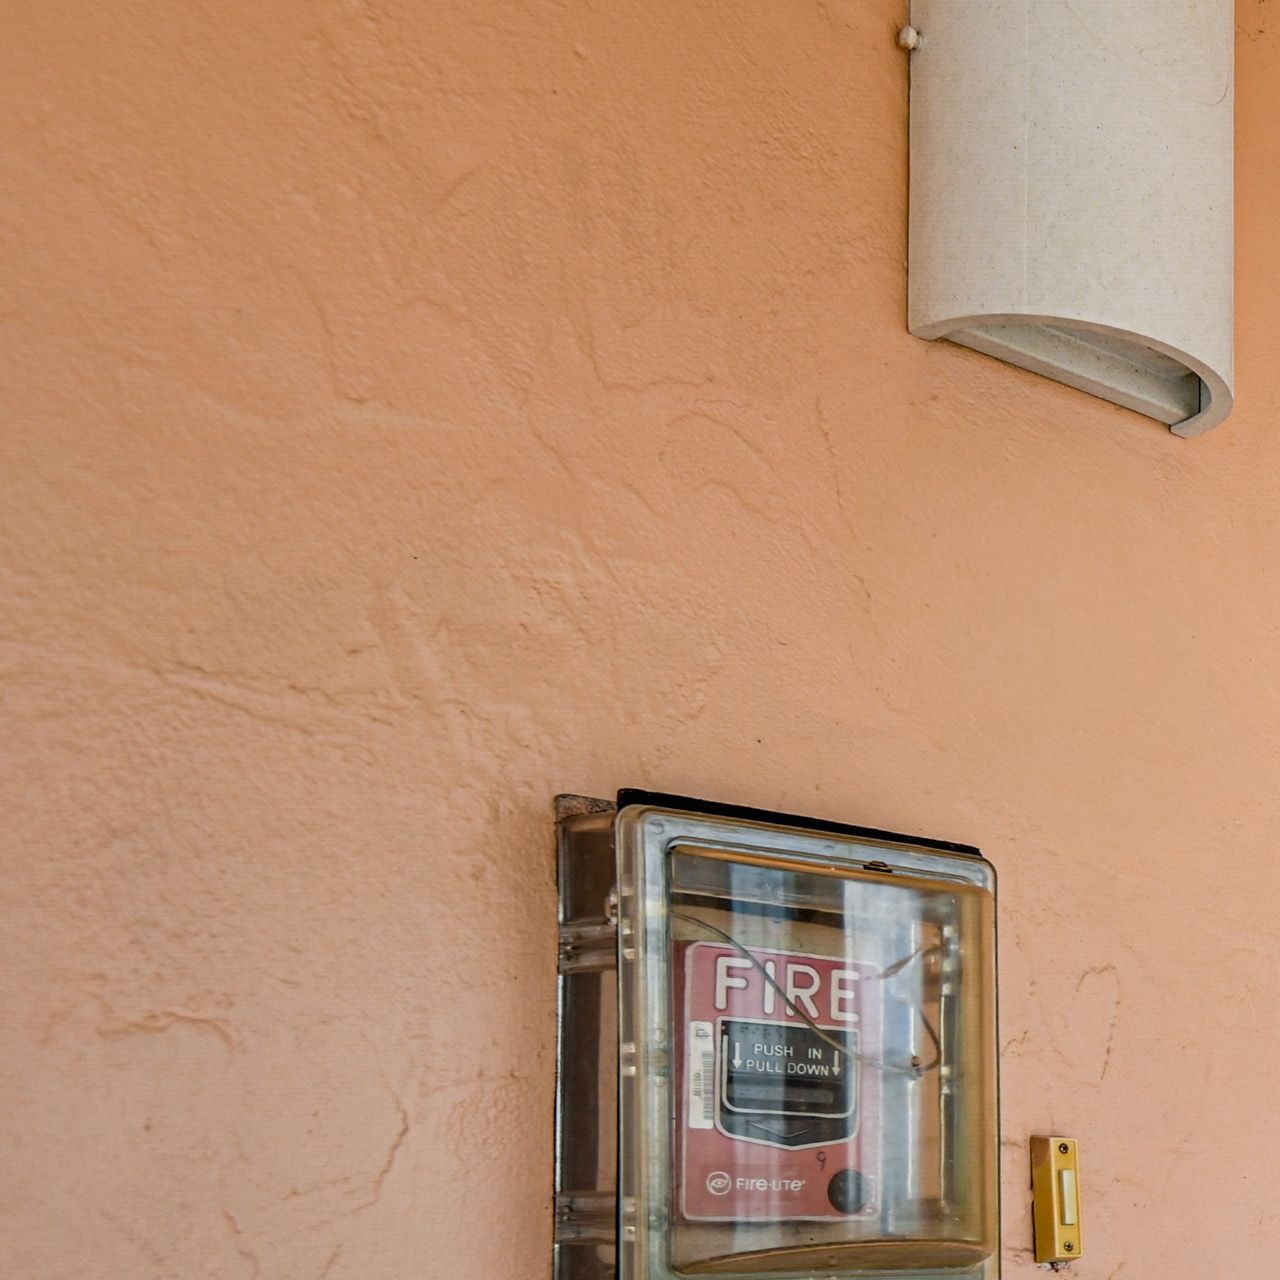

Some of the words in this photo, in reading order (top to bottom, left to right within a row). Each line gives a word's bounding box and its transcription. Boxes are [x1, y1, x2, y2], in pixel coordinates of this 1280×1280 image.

[715, 956, 860, 1022] FIRE
[754, 1043, 794, 1057] PUSH
[808, 1048, 822, 1059] IN
[746, 1059, 783, 1073] PULL
[787, 1062, 830, 1076] DOWN
